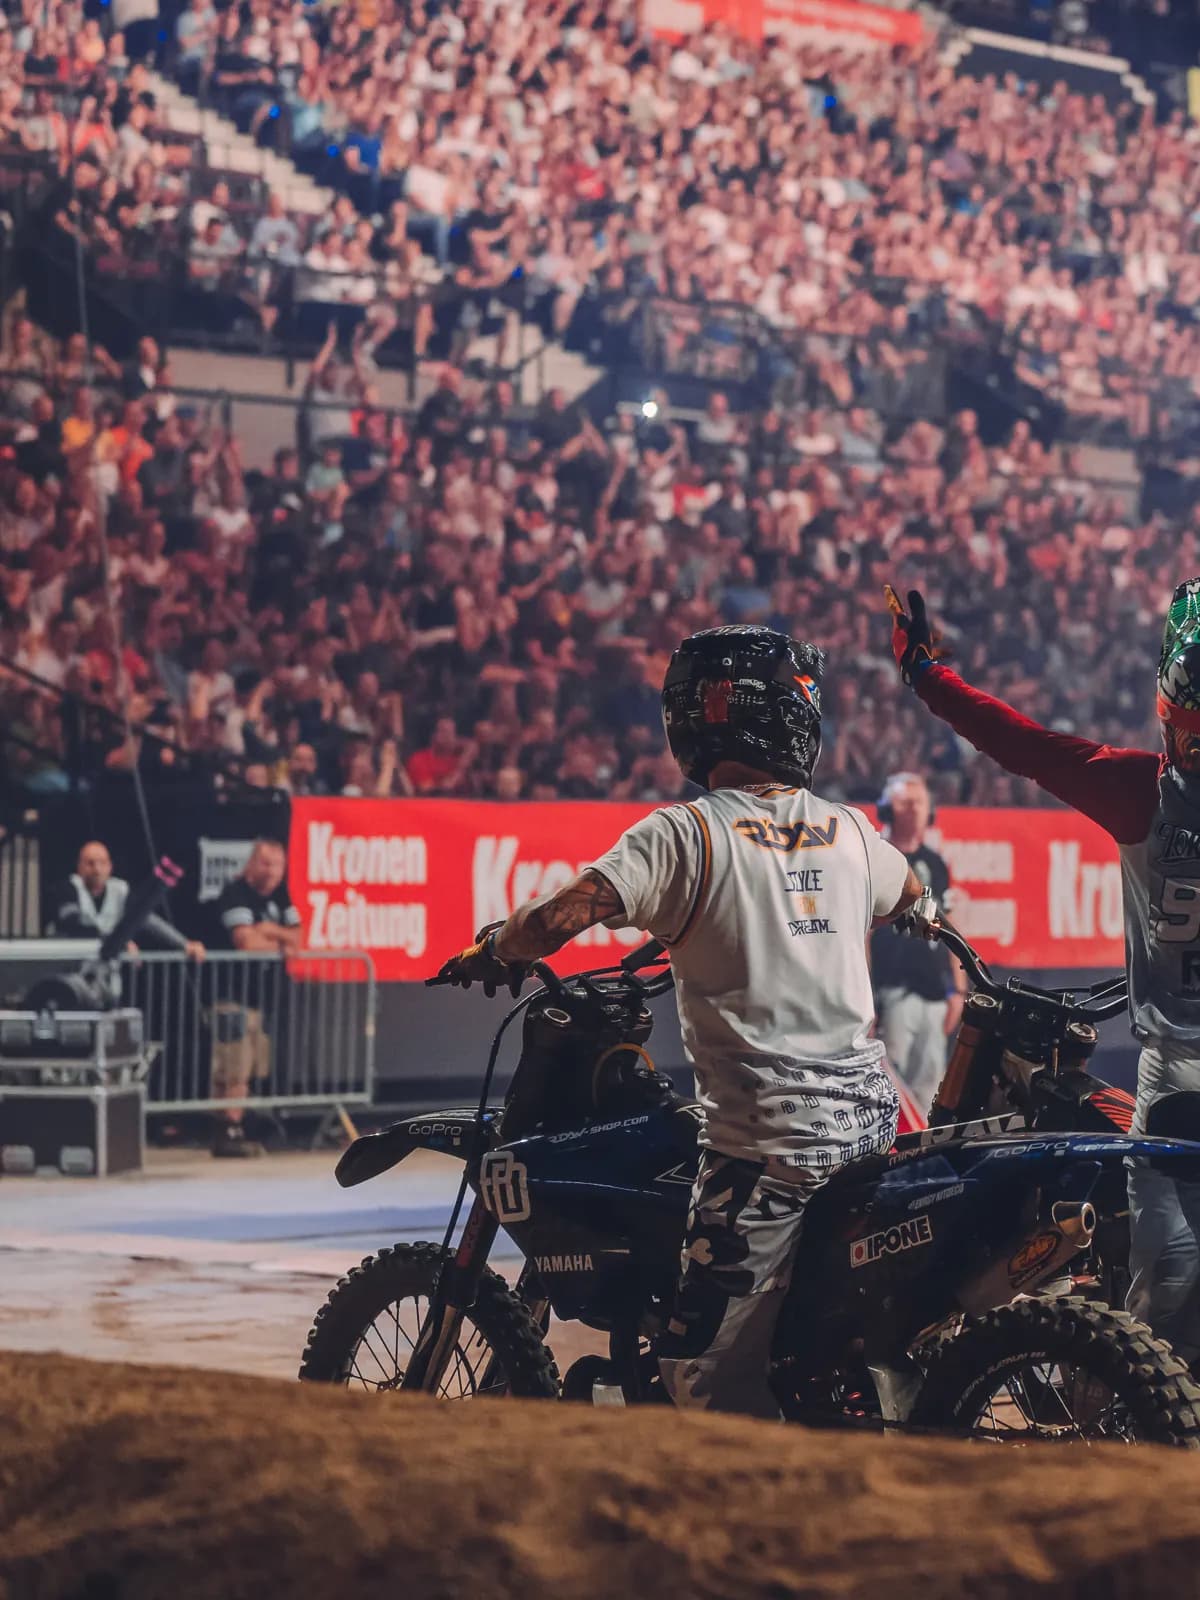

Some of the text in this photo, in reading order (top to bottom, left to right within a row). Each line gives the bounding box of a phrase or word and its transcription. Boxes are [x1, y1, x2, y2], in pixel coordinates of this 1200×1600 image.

[308, 821, 427, 884] Kronen
[1048, 840, 1124, 939] Kro
[308, 888, 427, 958] Zeitung
[408, 1123, 463, 1137] GoPro
[992, 1141, 1070, 1159] GoPro
[866, 1217, 931, 1259] IPONE
[535, 1254, 594, 1273] YAMAHA
